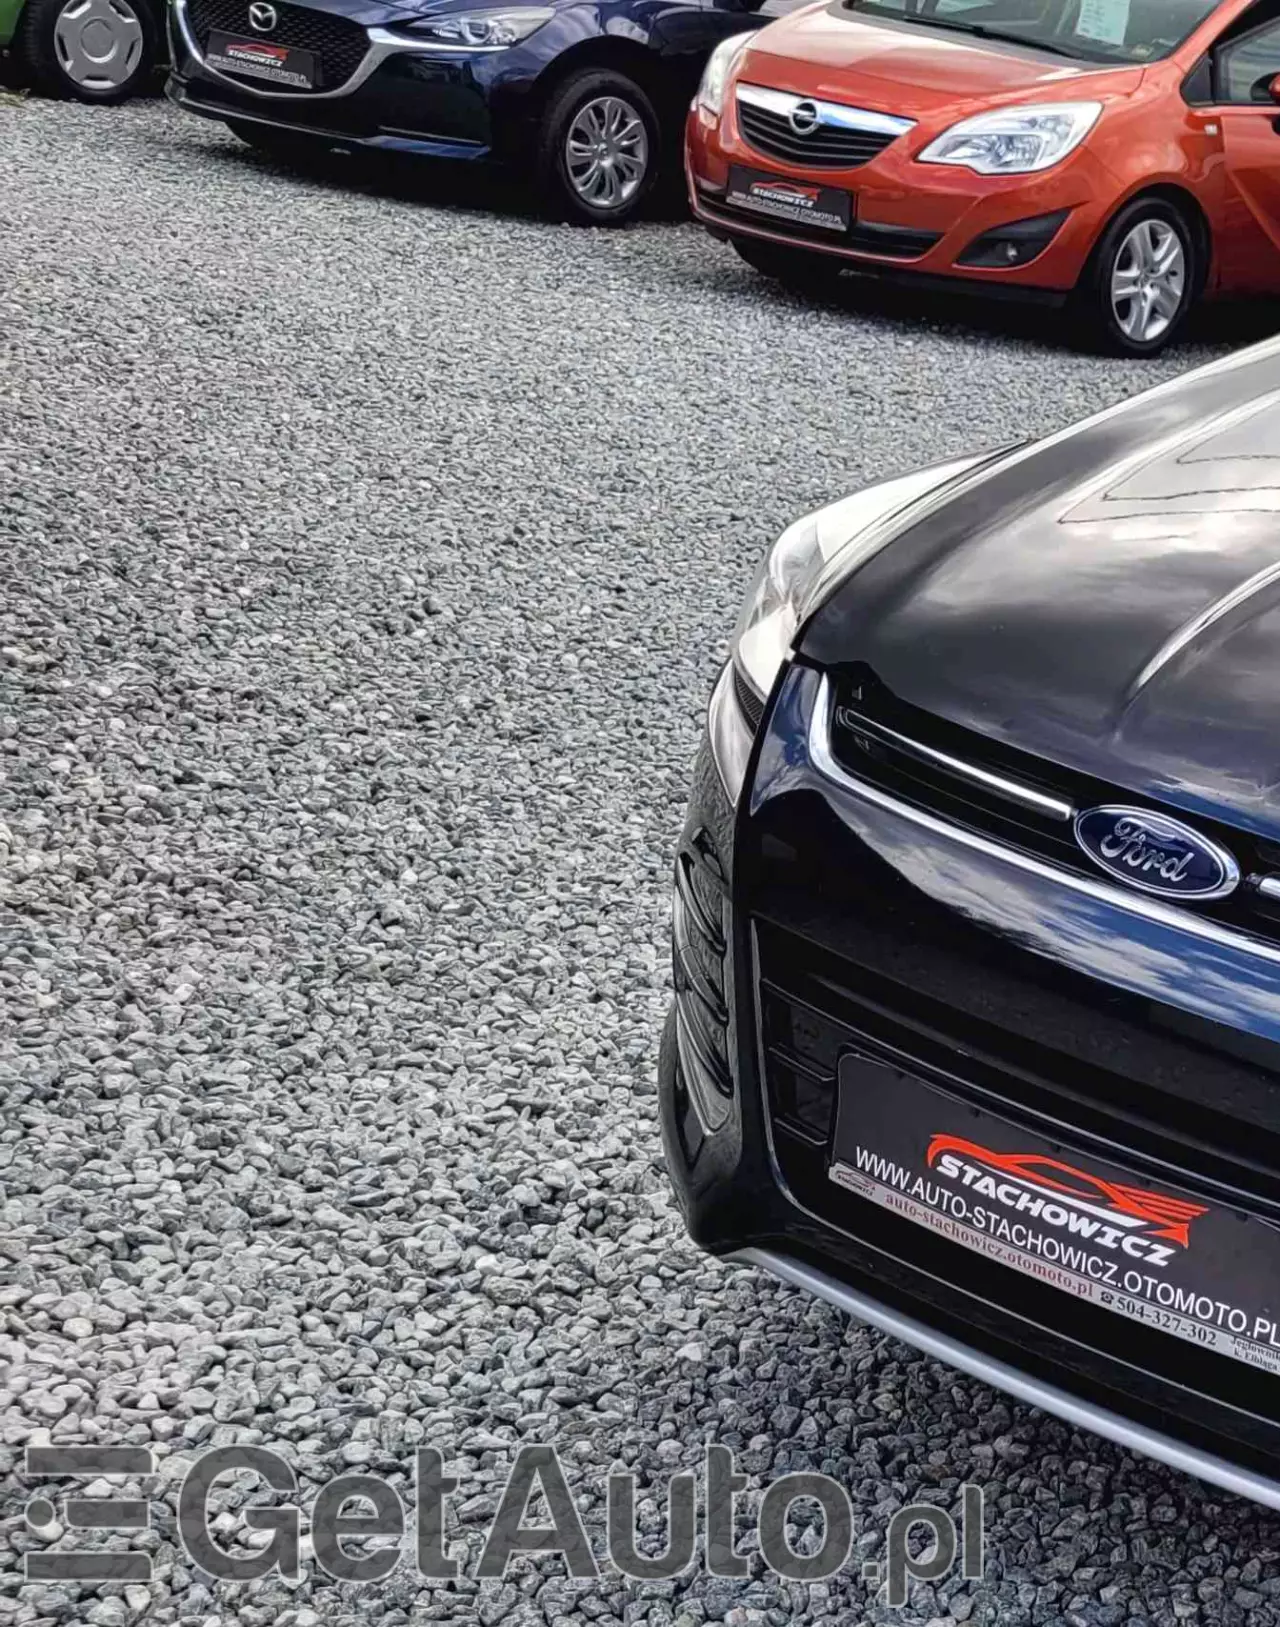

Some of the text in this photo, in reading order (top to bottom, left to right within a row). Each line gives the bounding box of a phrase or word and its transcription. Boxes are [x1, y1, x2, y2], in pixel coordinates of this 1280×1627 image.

[1099, 816, 1196, 883] Ford
[936, 1153, 1178, 1268] STACHOWICZ
[884, 1192, 1218, 1347] auto-stachowicz.otomoto.pl 504-327-302
